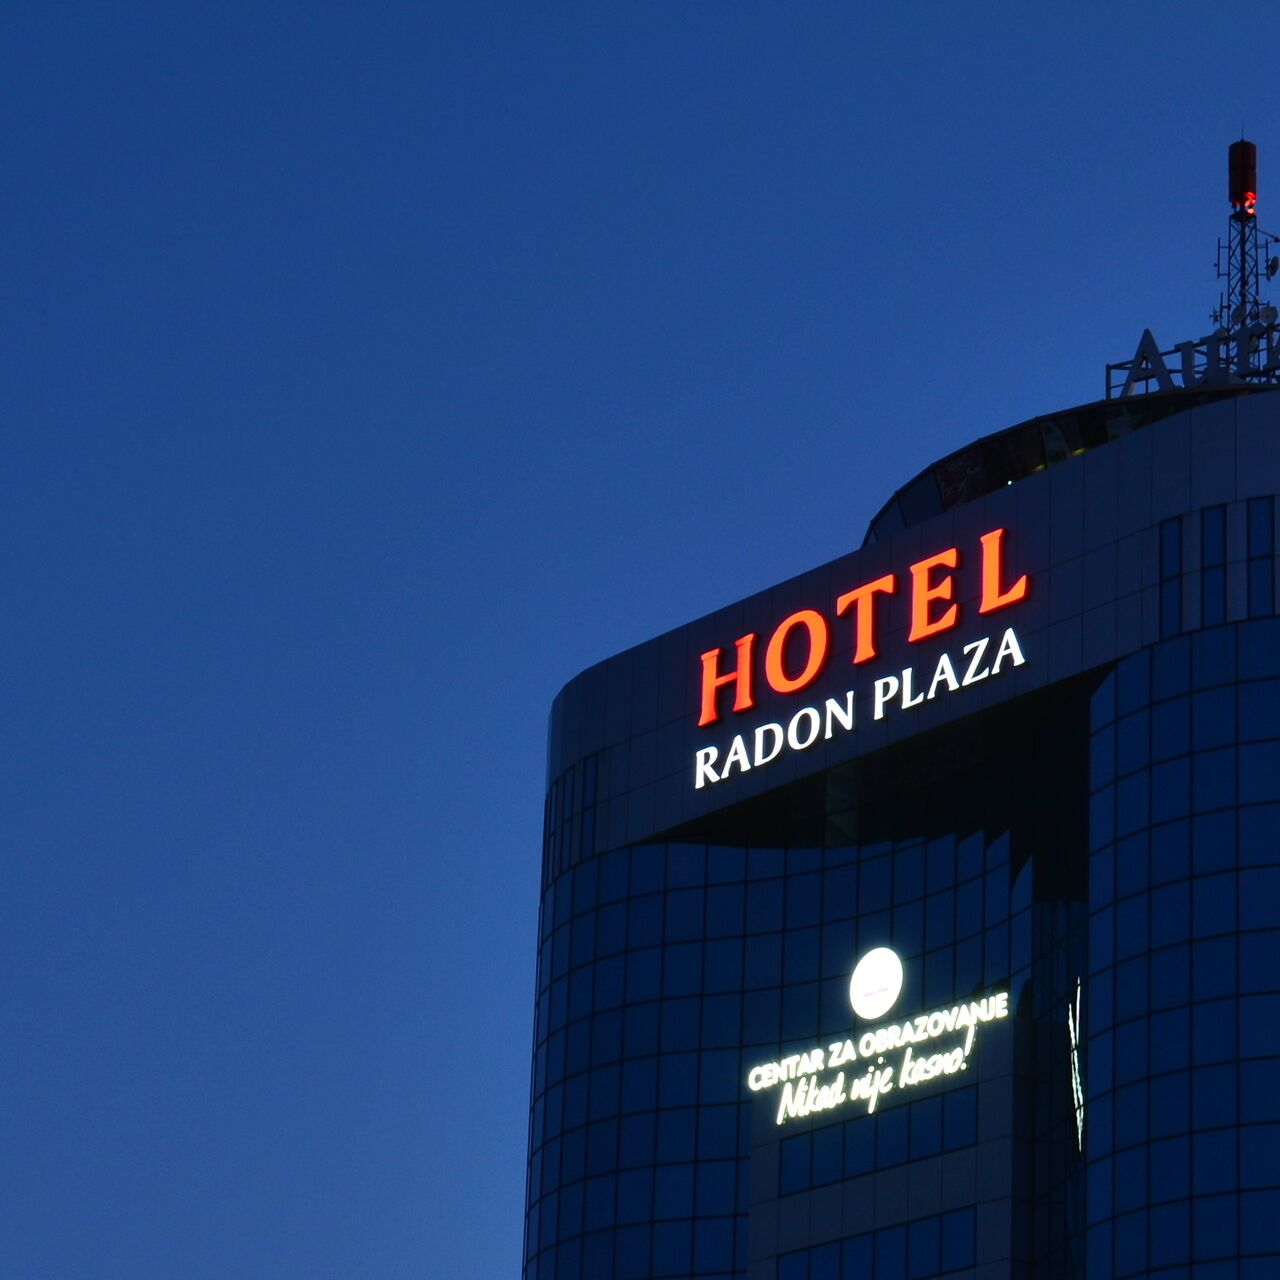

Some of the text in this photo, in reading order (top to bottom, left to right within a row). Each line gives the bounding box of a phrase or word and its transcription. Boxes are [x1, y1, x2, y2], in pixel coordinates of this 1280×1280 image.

[696, 527, 1030, 728] HOTEL
[694, 627, 1025, 788] RADON PLAZA
[748, 992, 1009, 1091] CENTAR ZA OBRAZOVANJE
[776, 1073, 846, 1125] Nikad
[851, 1056, 893, 1114] nije
